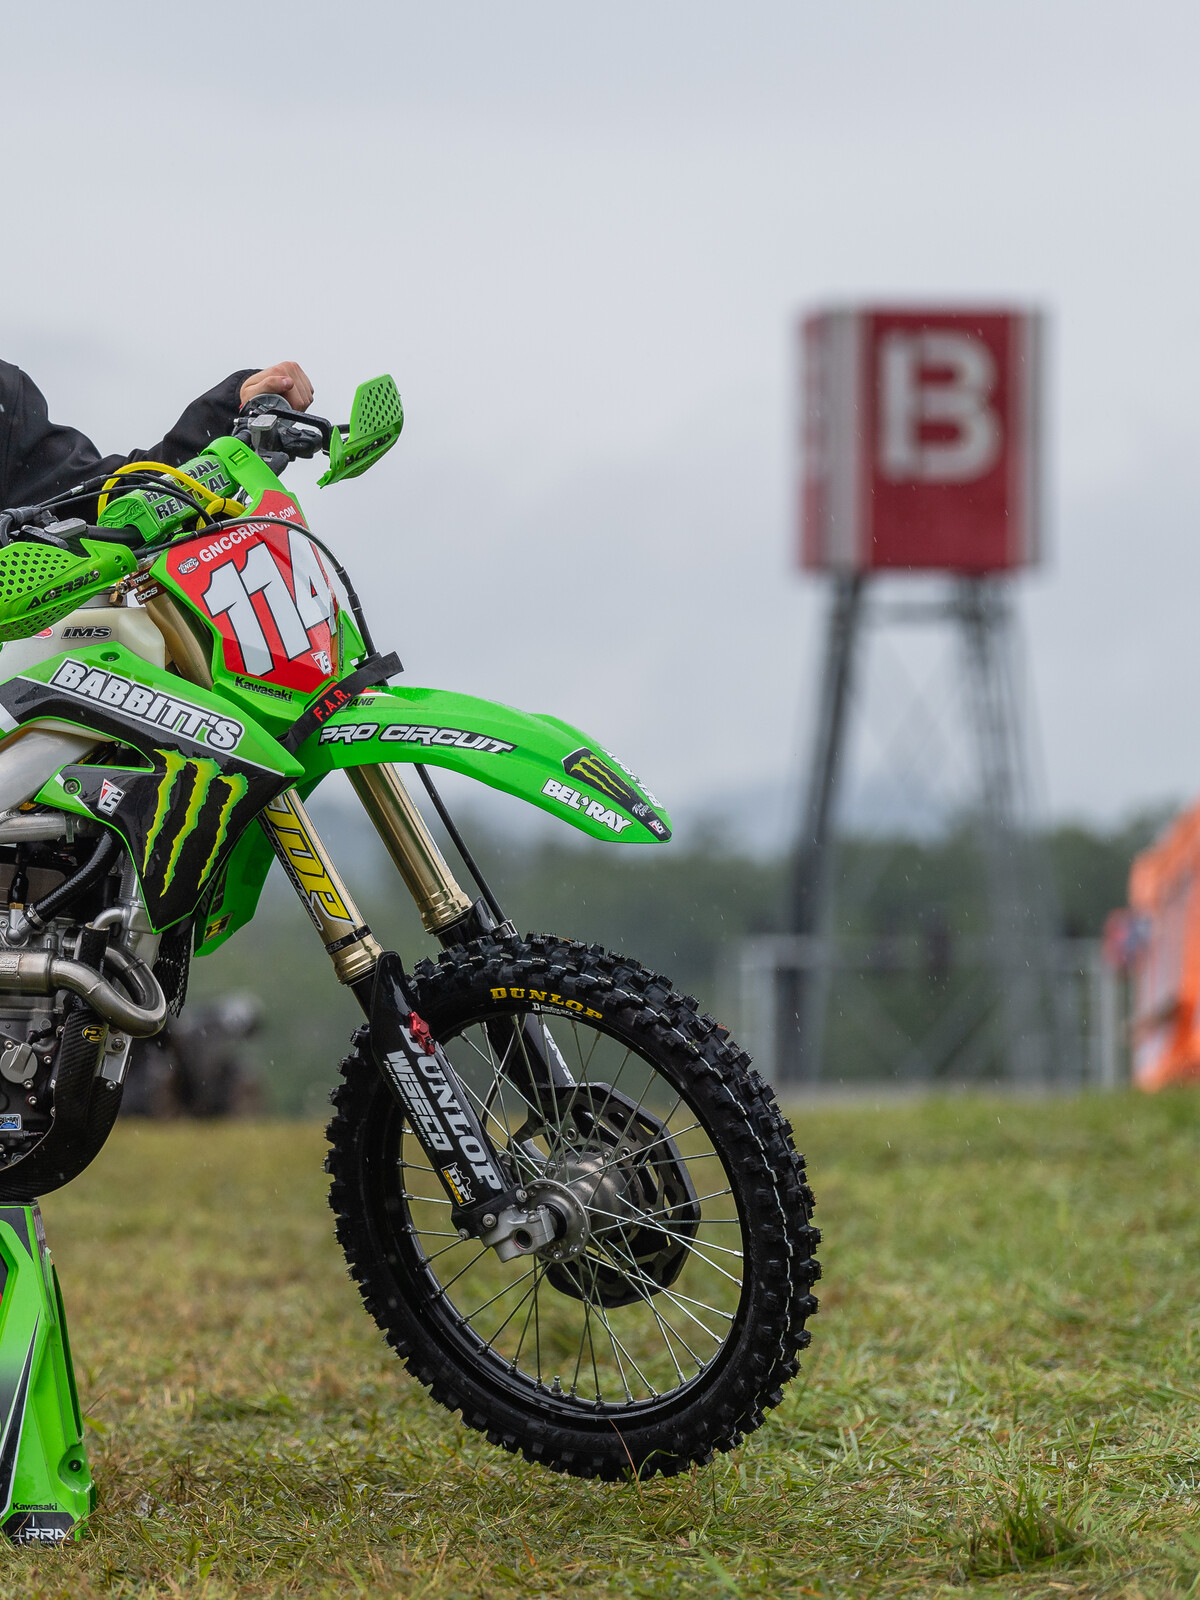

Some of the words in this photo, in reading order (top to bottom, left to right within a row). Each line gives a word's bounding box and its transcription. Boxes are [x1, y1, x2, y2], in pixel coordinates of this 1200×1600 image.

[878, 330, 1000, 484] B
[201, 527, 337, 678] 114
[61, 626, 112, 639] IMS
[53, 660, 242, 750] BABBITT'S
[234, 676, 293, 702] Kawasaki
[312, 688, 352, 722] F.A.R.
[318, 722, 379, 747] PRO
[379, 723, 519, 754] CIRCUIT
[490, 987, 603, 1019] DUNLOP
[386, 1050, 454, 1151] WISECO
[446, 1166, 471, 1201] DP
[12, 1502, 58, 1511] Kawasaki
